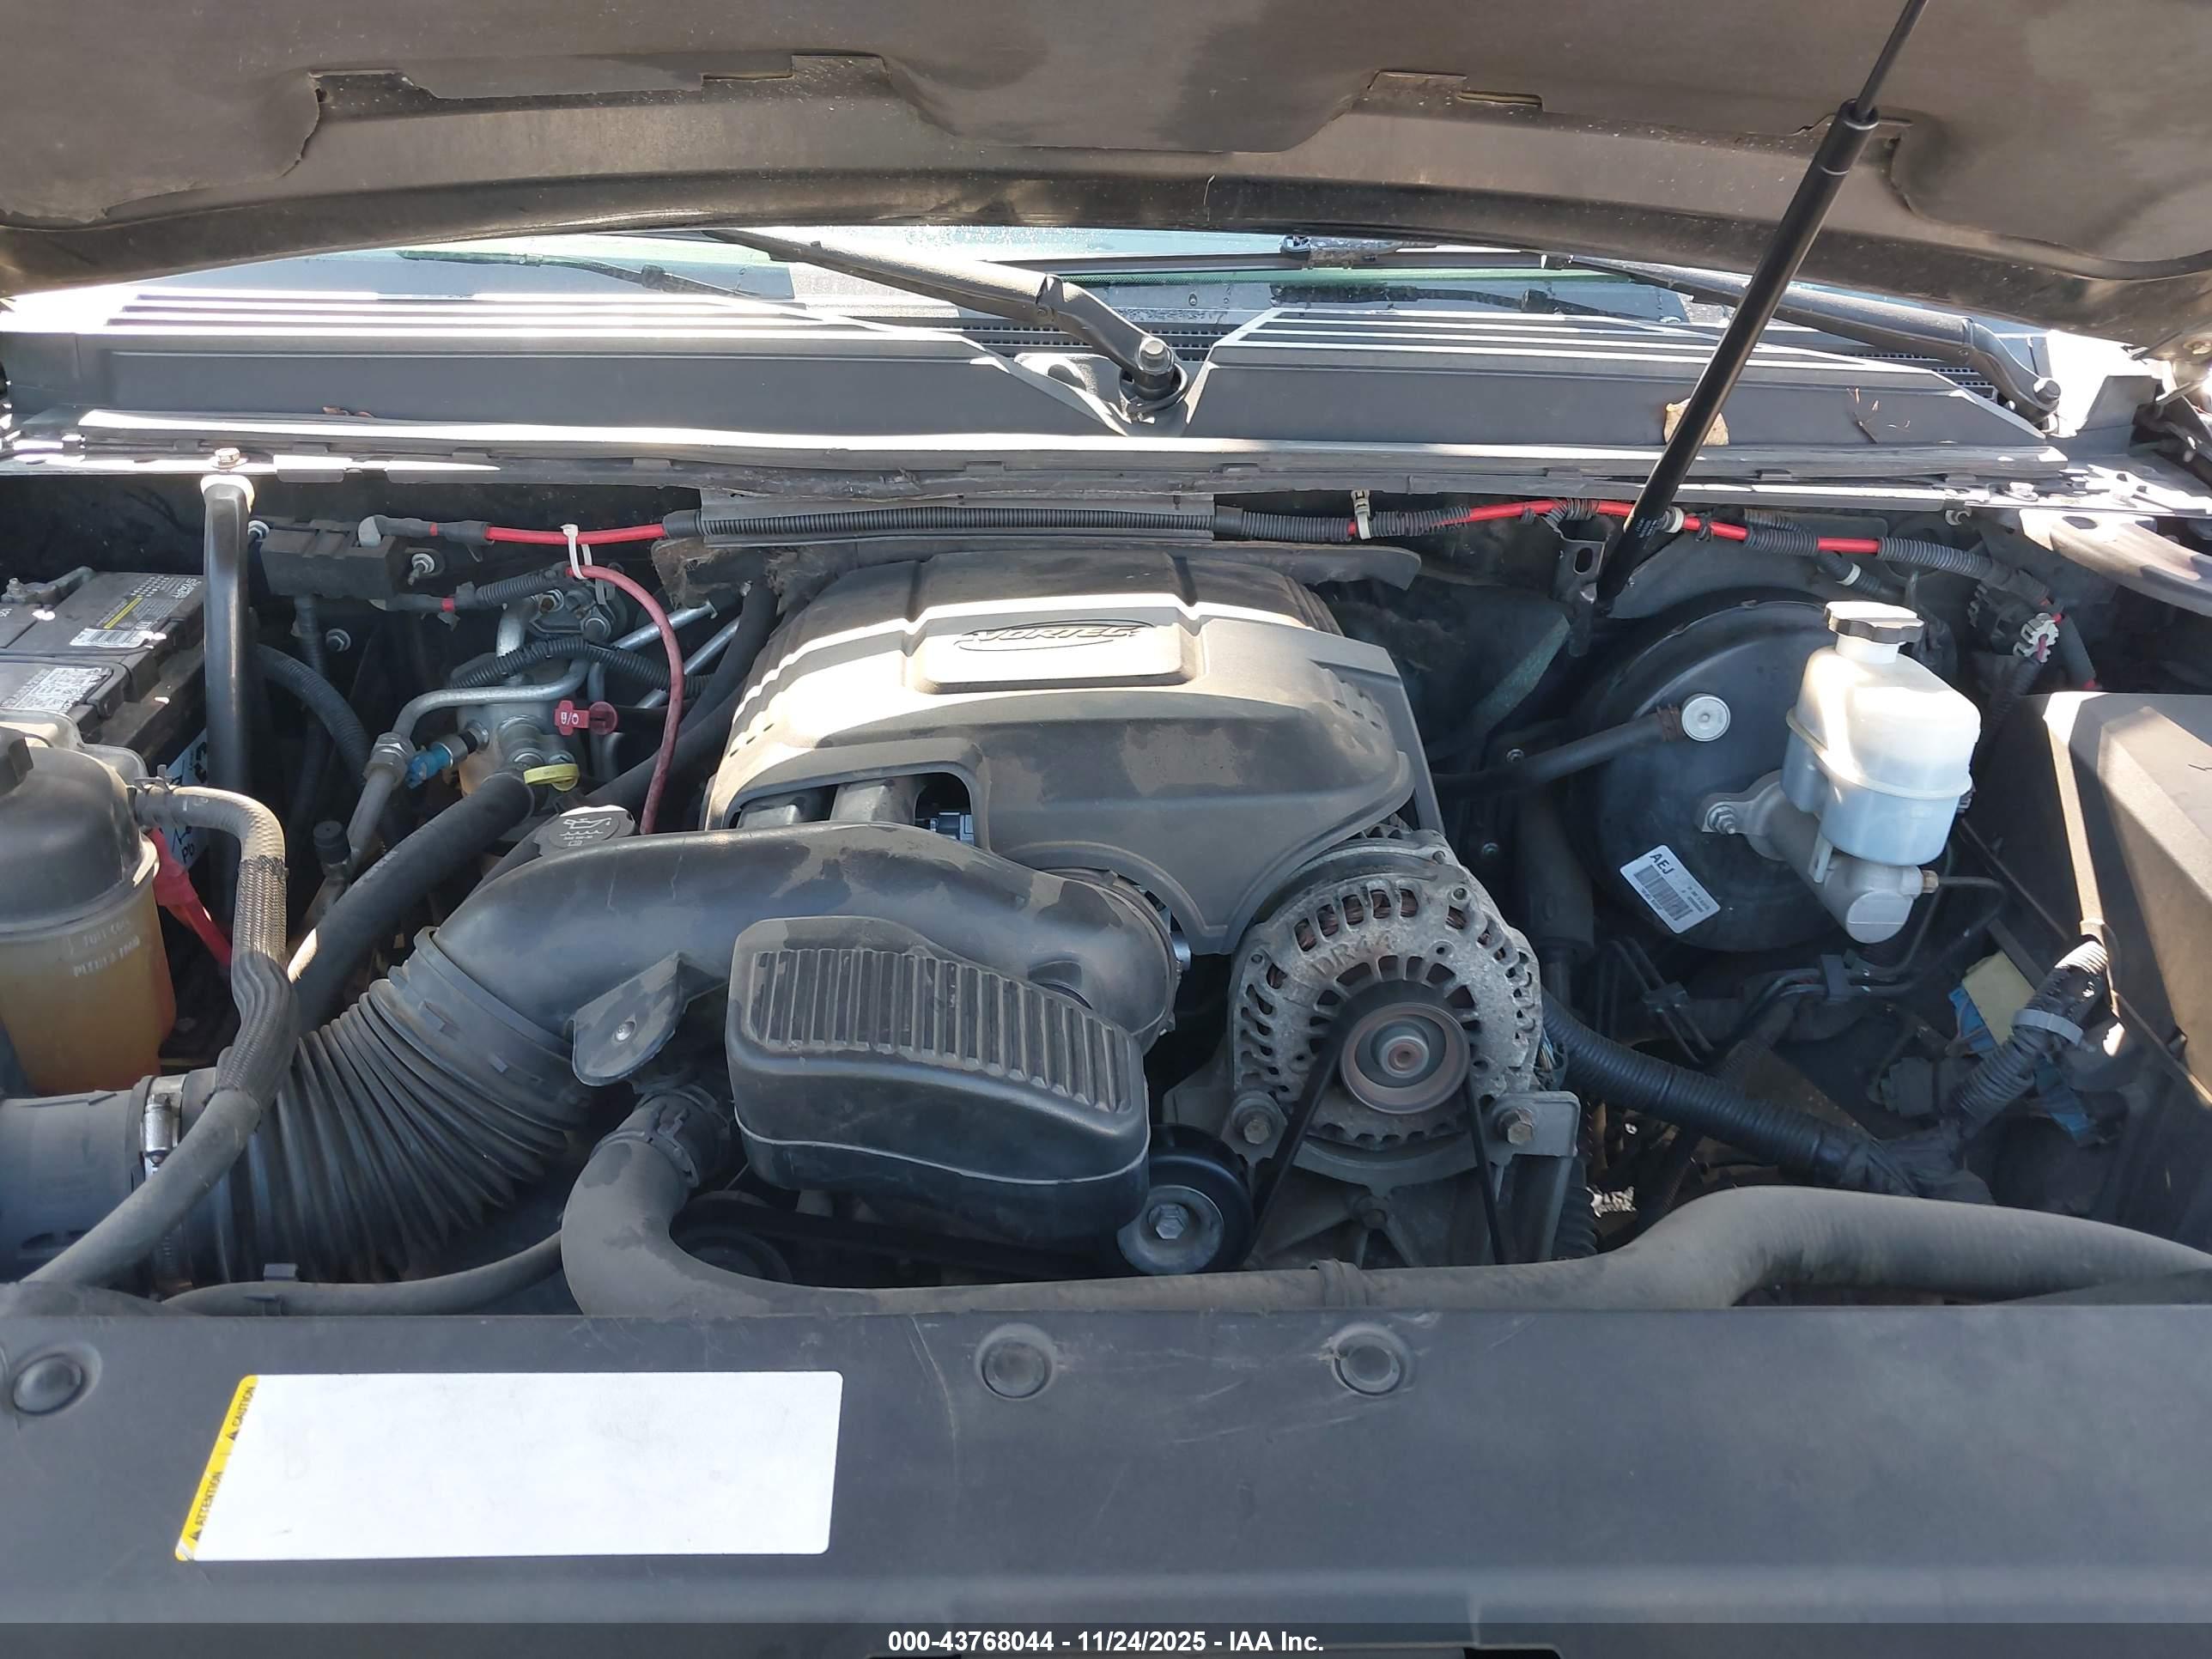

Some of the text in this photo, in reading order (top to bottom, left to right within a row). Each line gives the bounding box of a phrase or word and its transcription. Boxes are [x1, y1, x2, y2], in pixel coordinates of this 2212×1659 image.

[974, 626, 1139, 641] VORTEC
[1649, 853, 1675, 875] AEJ
[232, 1386, 257, 1428] CAUTION
[194, 1471, 223, 1526] ATTENTION
